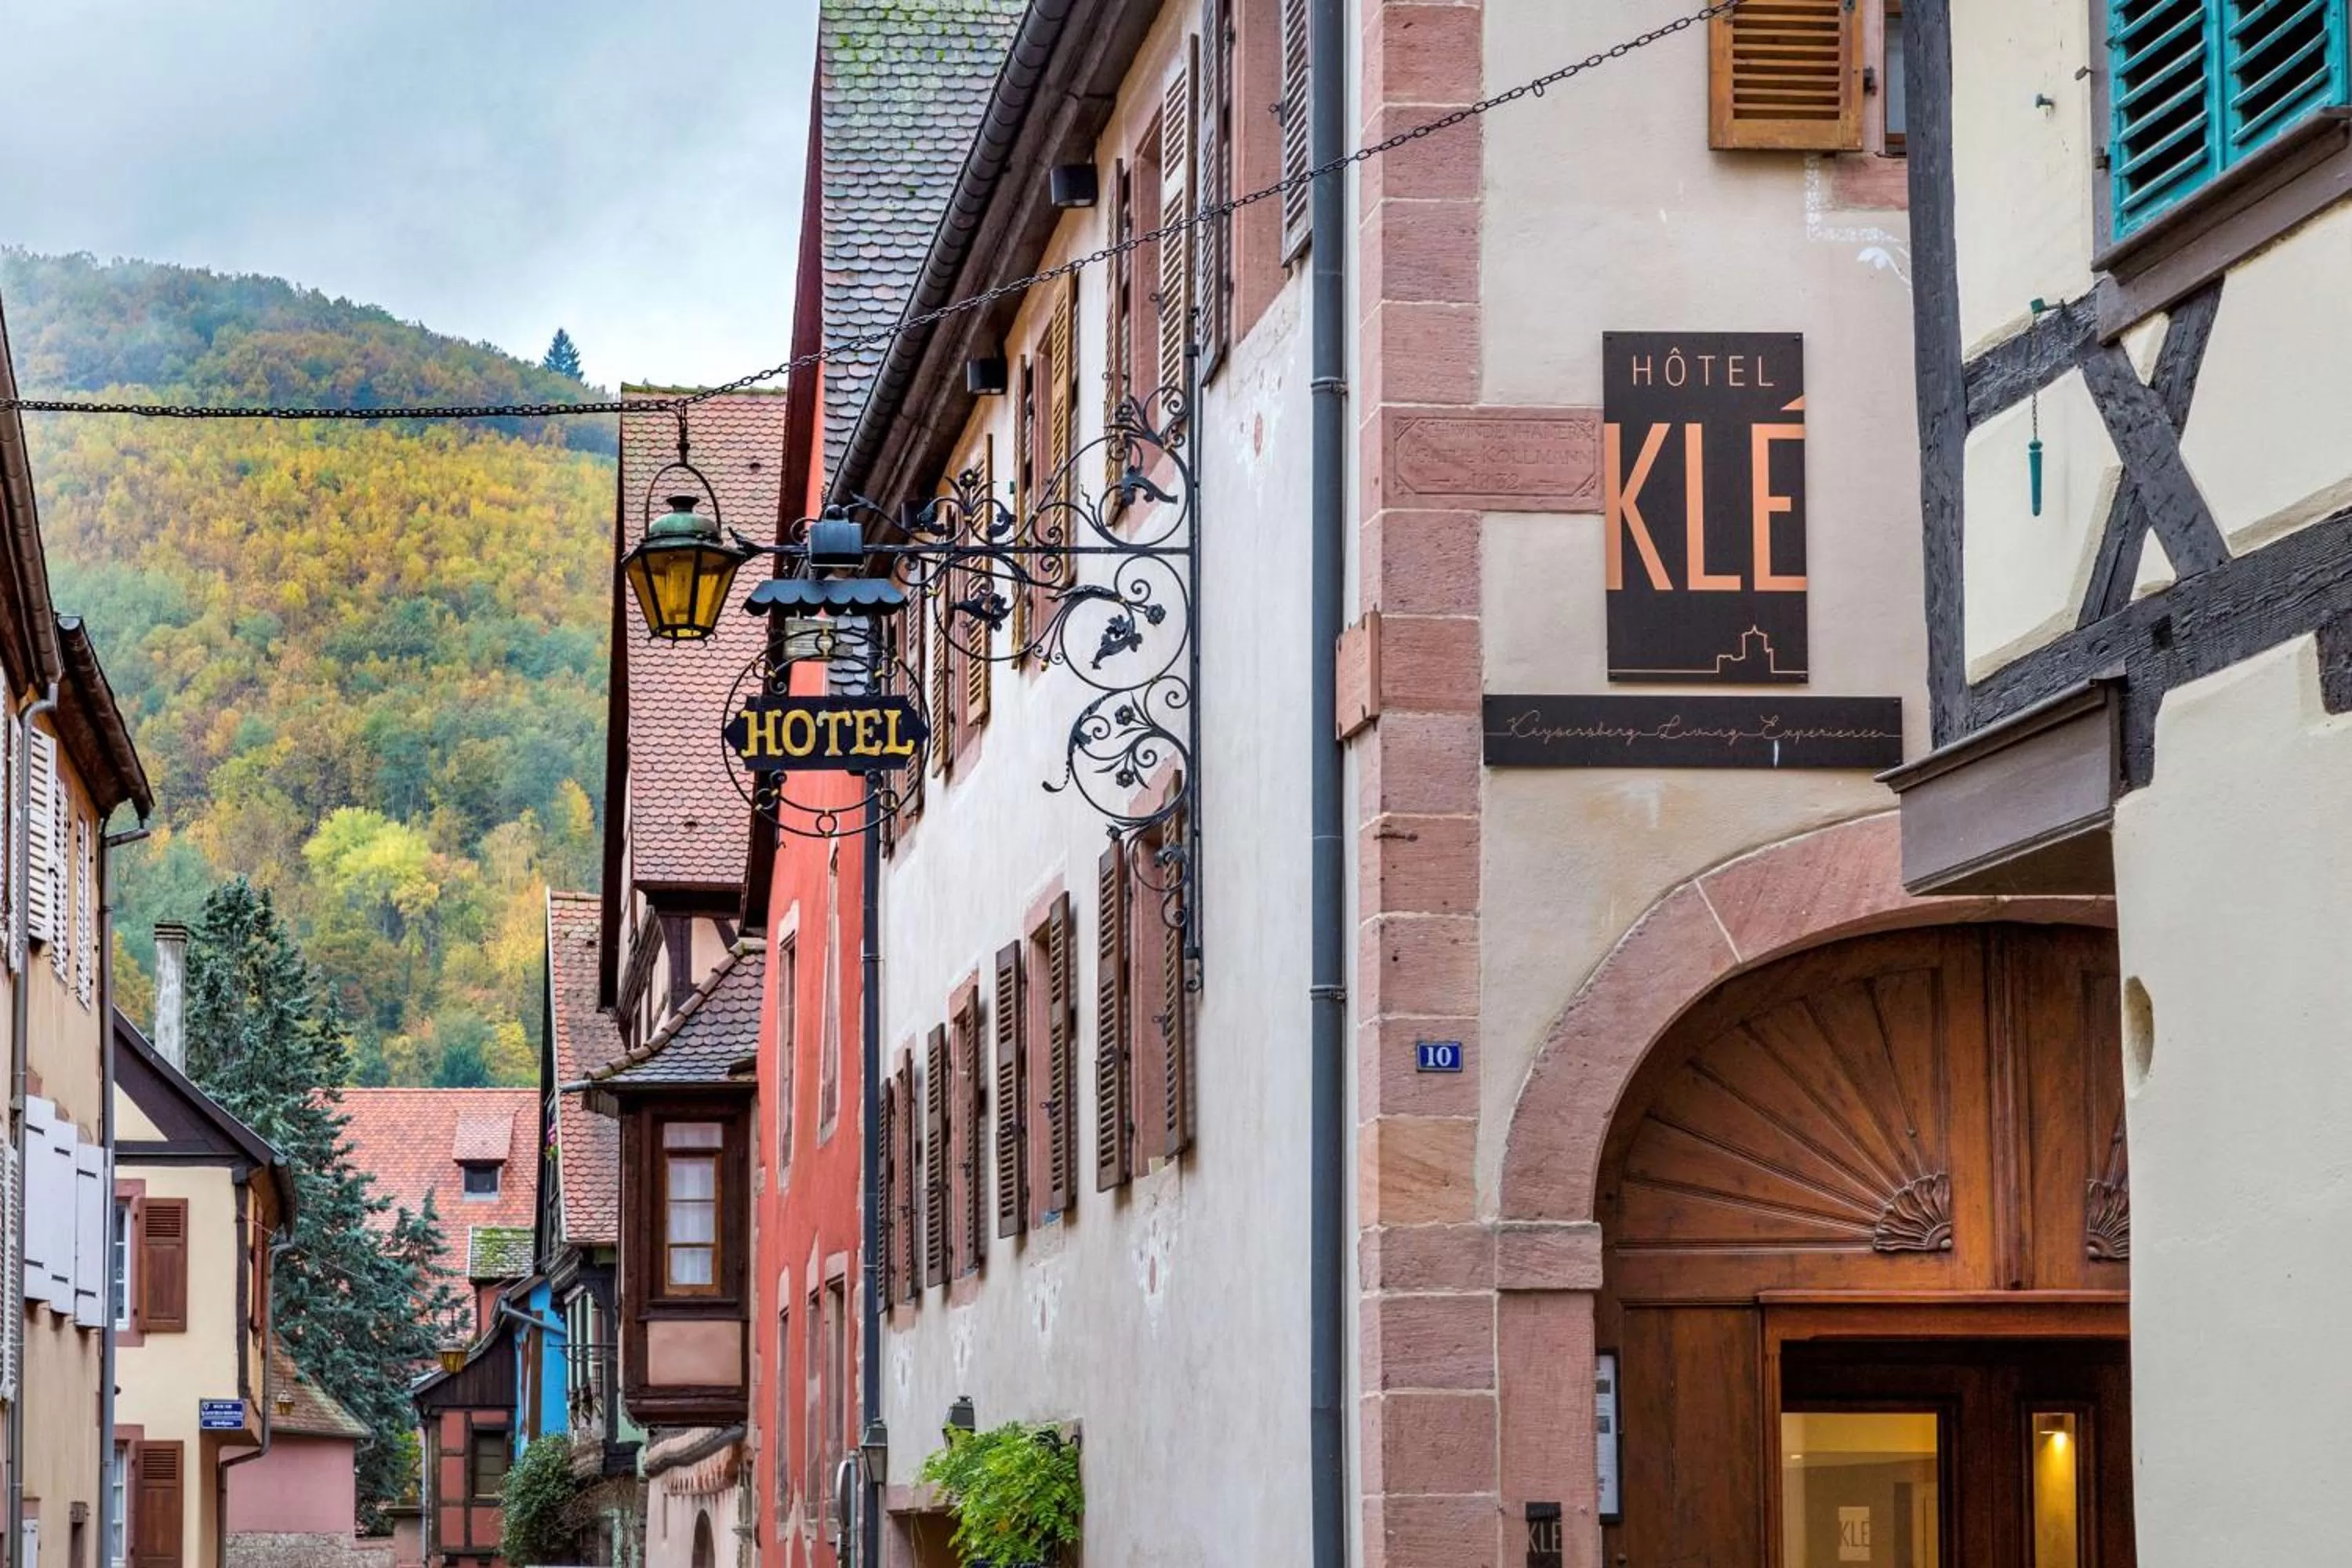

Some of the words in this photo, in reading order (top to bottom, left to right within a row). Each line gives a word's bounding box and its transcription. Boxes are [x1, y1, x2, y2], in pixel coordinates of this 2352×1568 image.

[1632, 347, 1775, 387] HÔTEL
[1603, 394, 1807, 591] KLÉ
[740, 709, 915, 757] HOTEL
[1426, 1047, 1452, 1067] 10
